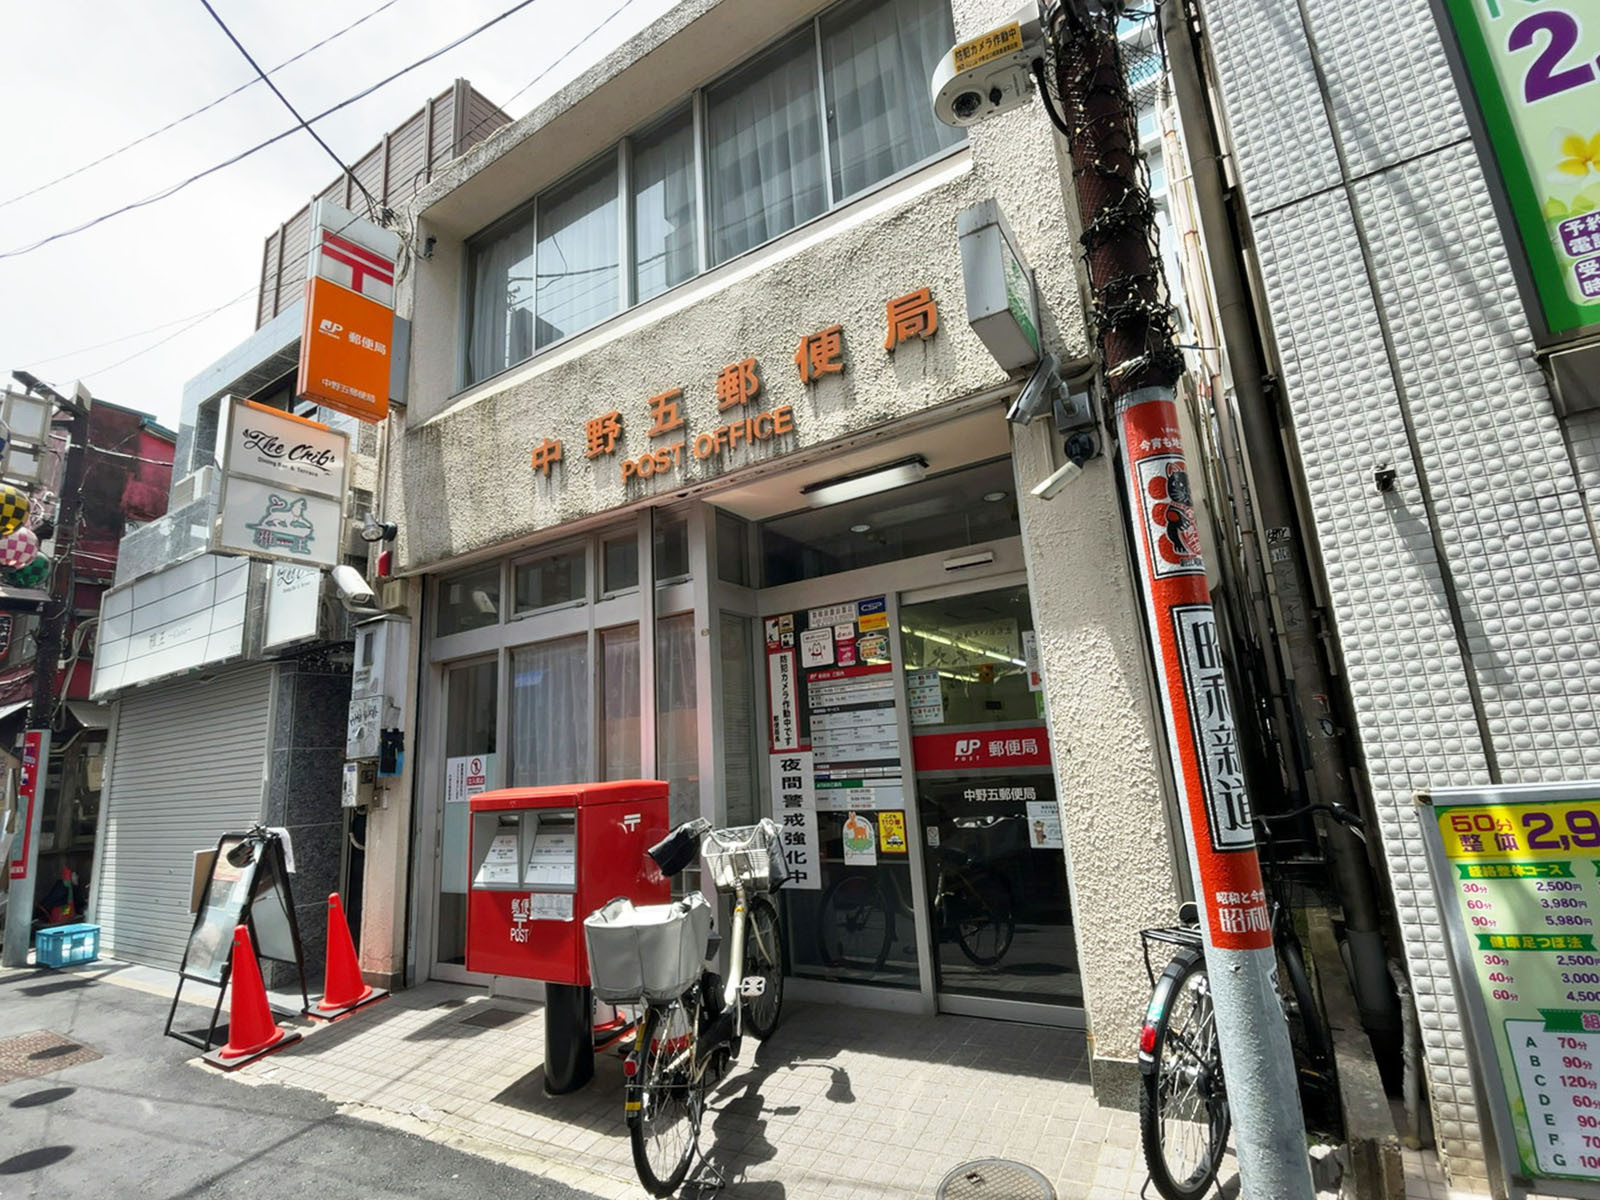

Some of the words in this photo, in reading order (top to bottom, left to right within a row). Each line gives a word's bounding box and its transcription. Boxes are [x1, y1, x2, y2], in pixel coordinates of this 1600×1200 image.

[348, 331, 387, 355] 郵便局
[531, 286, 939, 478] 中野五郵便局
[321, 379, 376, 403] 中野五郵便局
[244, 430, 287, 458] The
[620, 441, 686, 483] POST
[693, 405, 796, 461] OFFICE
[988, 738, 1038, 757] 郵便局
[963, 787, 1037, 802] 中野五郵便局
[780, 758, 808, 884] 夜間警戒強化中
[1450, 814, 1513, 833] 50分
[1463, 883, 1488, 893] 30分
[1536, 881, 1583, 892] 2,500円
[1467, 900, 1492, 910] 60分
[1541, 898, 1588, 909] 3,980円
[1471, 916, 1497, 927] 90分
[1545, 915, 1593, 926] 5,980円
[510, 927, 529, 943] POST
[1483, 955, 1509, 966] 30分
[1489, 972, 1514, 983] 40分
[1493, 989, 1518, 1001] 60分
[1526, 1036, 1537, 1048] A
[1557, 1037, 1587, 1051] 70分
[1530, 1055, 1541, 1067] B
[1562, 1056, 1592, 1069] 90分
[1534, 1074, 1547, 1087] C
[1559, 1075, 1597, 1089] 120分
[1539, 1094, 1550, 1106] D
[1544, 1113, 1555, 1126] E
[1548, 1133, 1559, 1146] F
[1553, 1154, 1567, 1167] G
